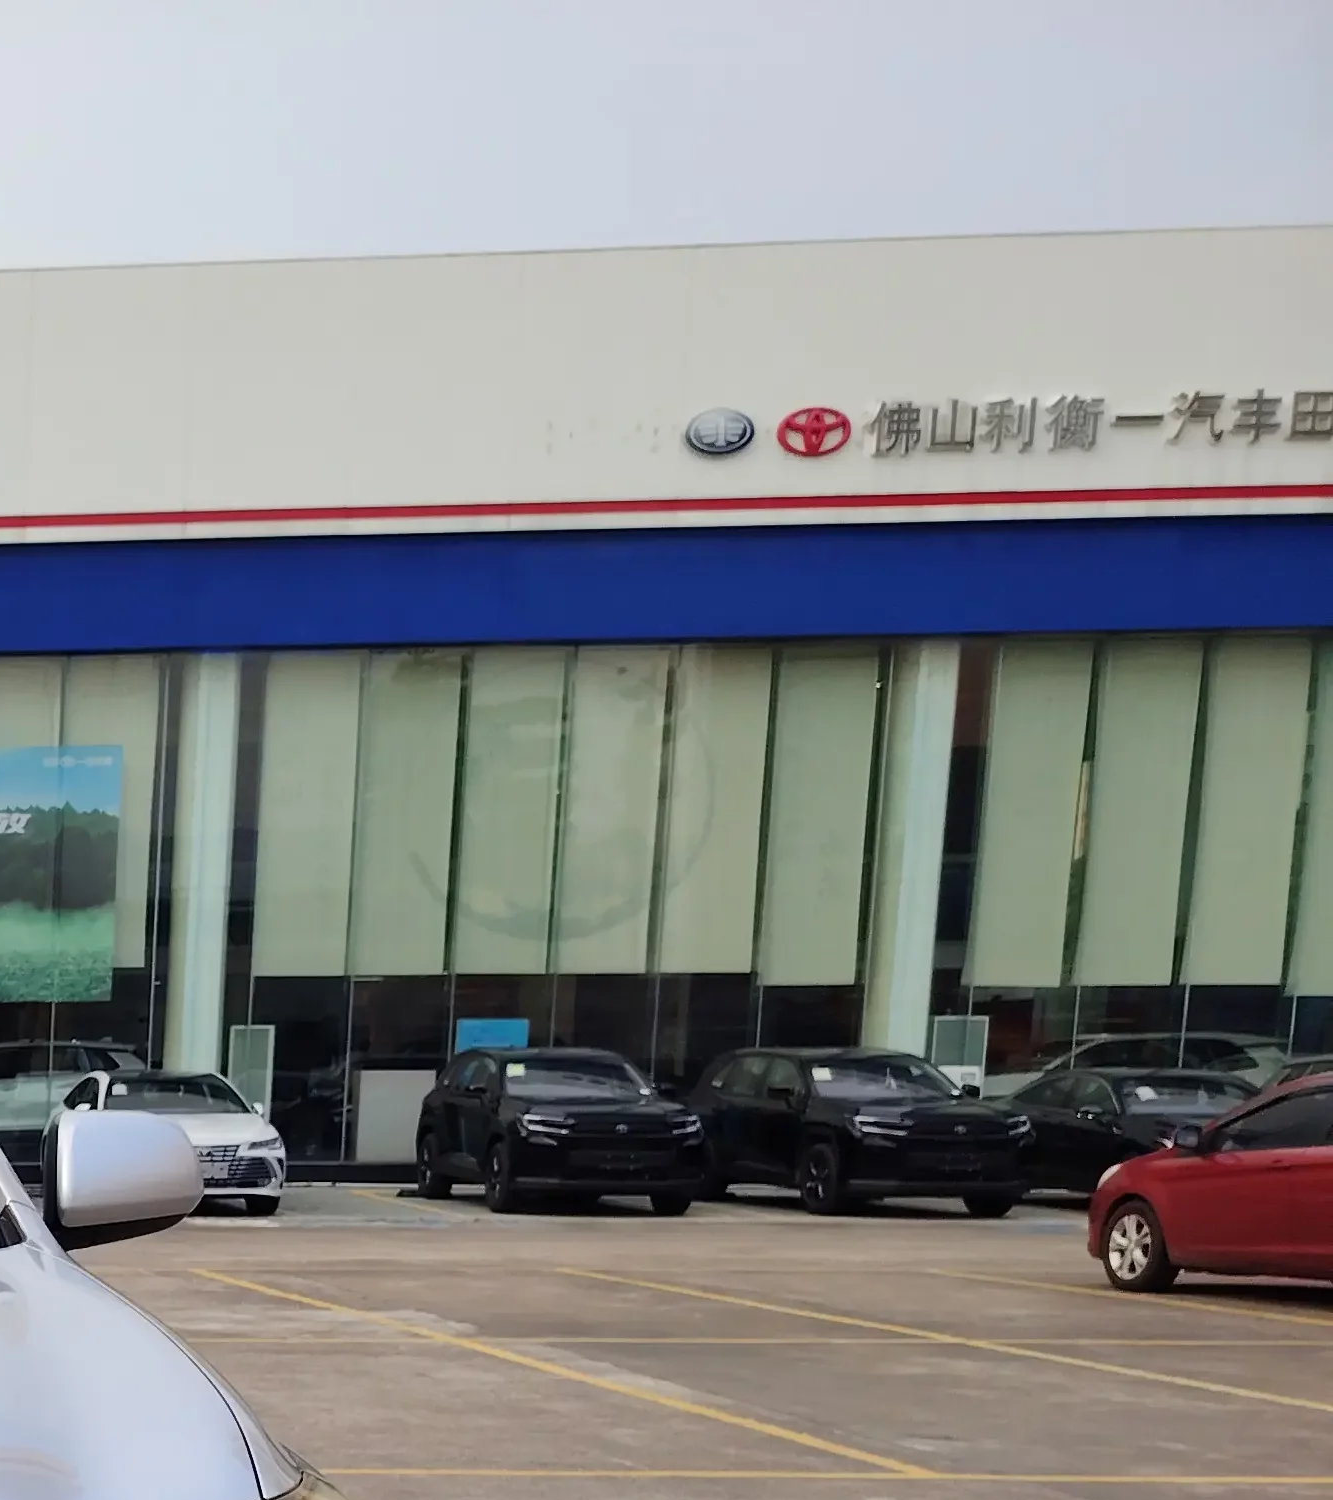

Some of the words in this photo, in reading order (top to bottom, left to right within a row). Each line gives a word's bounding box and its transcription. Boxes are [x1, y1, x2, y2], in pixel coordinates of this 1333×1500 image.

[867, 387, 1333, 456] 佛山利衡一汽丰田
